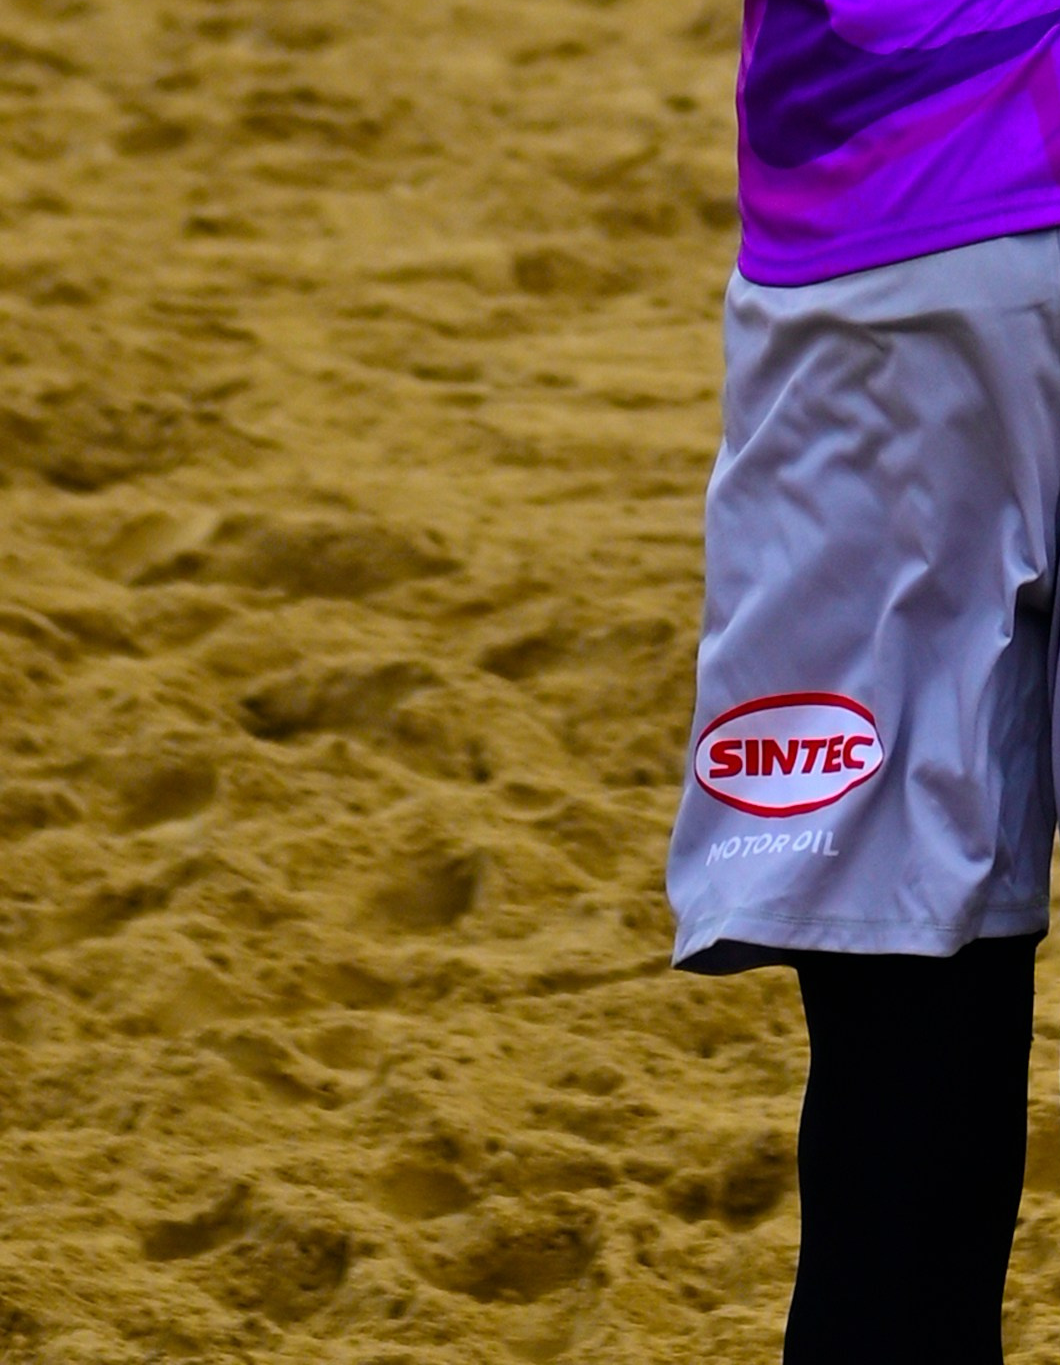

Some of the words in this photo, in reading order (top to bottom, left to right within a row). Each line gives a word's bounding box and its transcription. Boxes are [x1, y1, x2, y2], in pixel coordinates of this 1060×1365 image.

[709, 735, 875, 779] SINTEC
[705, 833, 786, 866] MOTOR
[792, 830, 840, 857] OIL
